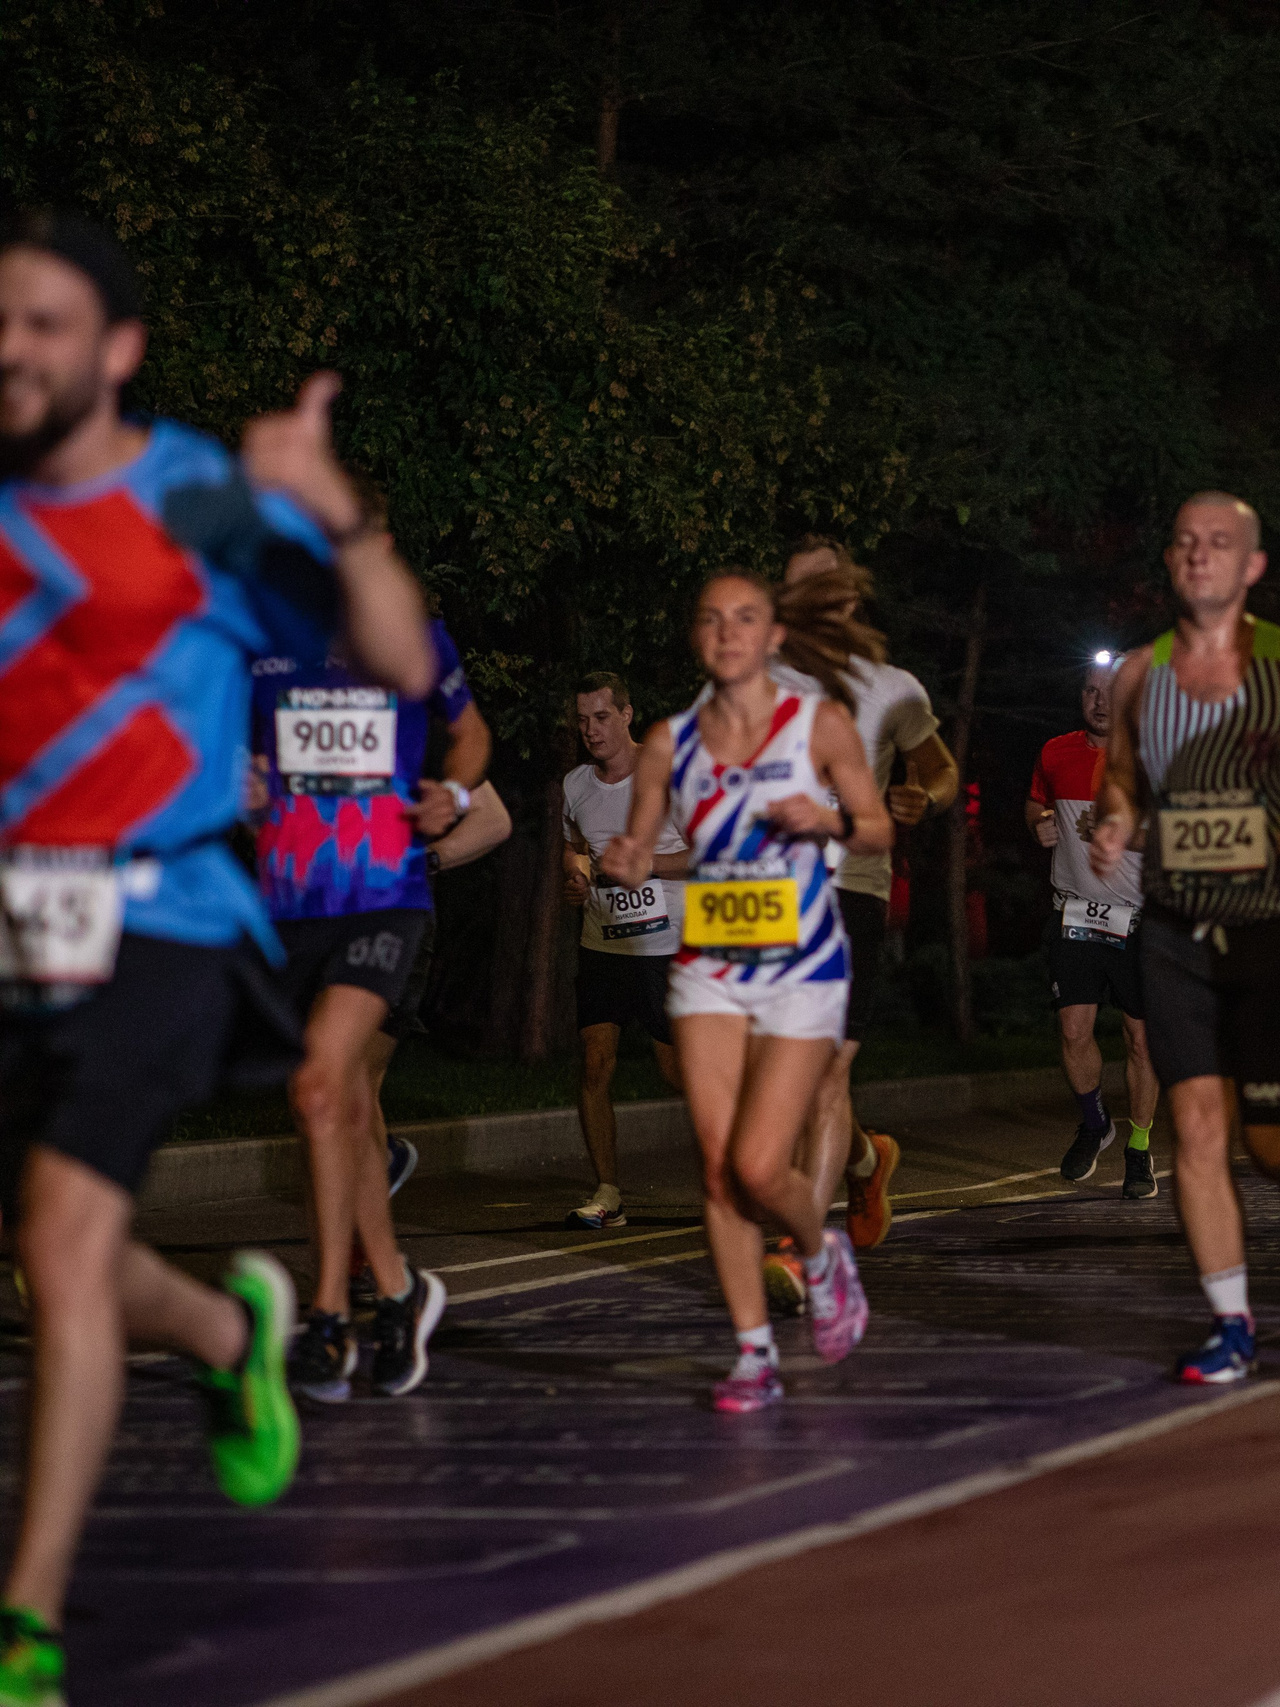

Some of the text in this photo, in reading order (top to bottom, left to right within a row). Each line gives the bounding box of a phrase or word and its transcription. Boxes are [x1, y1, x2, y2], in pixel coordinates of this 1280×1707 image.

[294, 720, 379, 752] 9006
[1173, 817, 1253, 851] 2024
[606, 886, 656, 913] 7808
[700, 889, 784, 925] 9005
[1086, 901, 1112, 920] 82
[615, 909, 648, 920] НИКОЛАЙ
